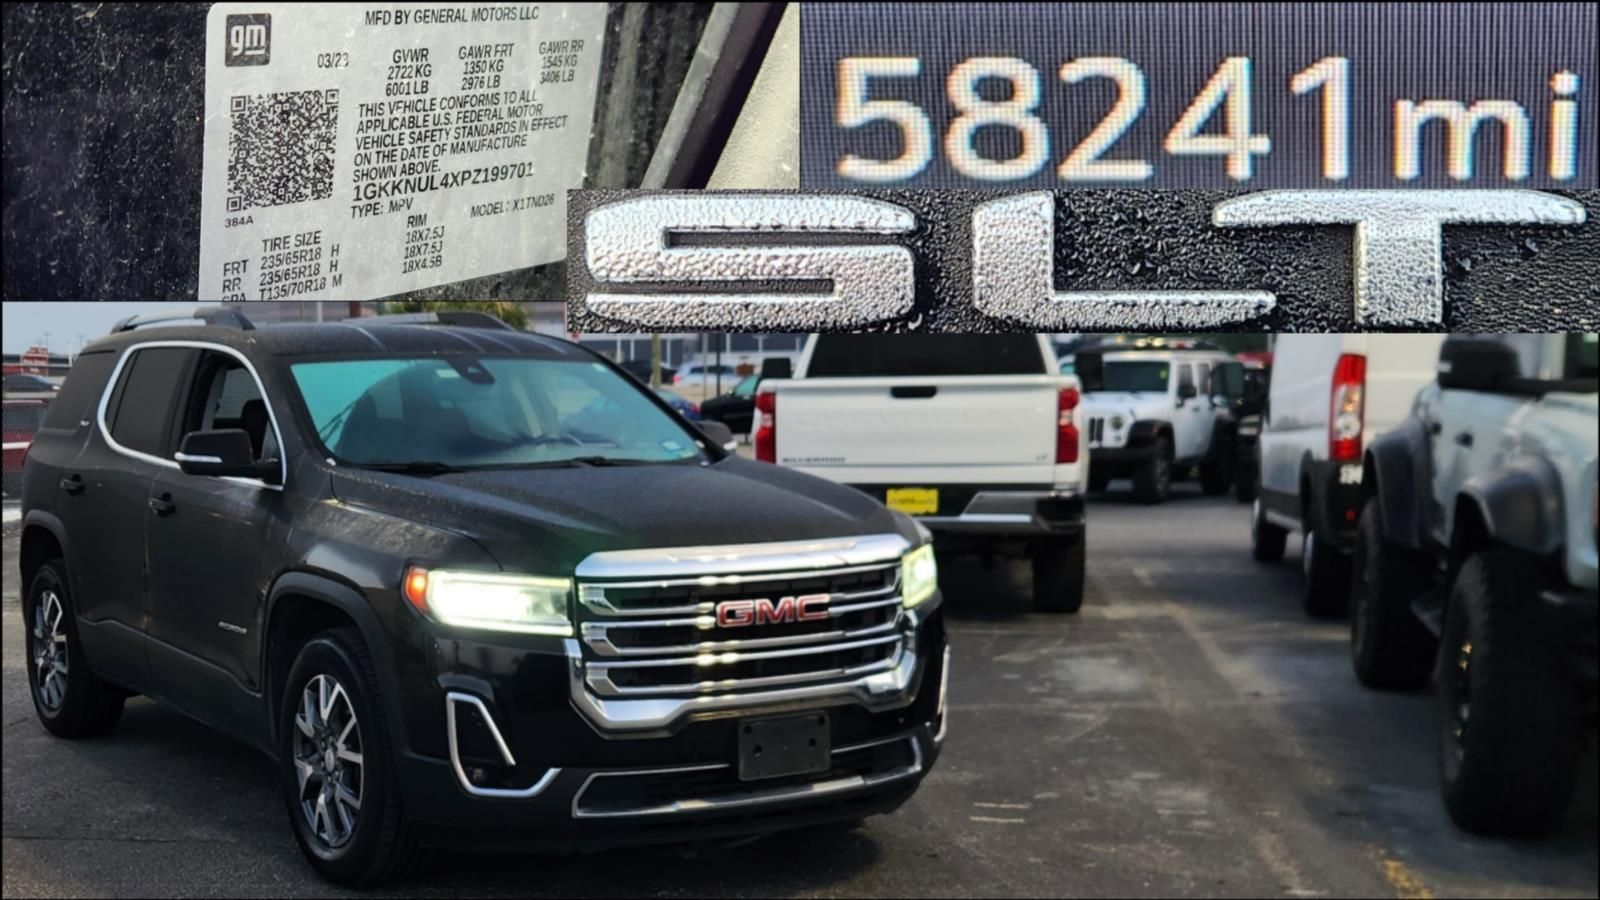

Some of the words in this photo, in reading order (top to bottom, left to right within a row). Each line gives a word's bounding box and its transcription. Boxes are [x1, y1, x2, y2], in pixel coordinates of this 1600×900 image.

[365, 11, 391, 25] MFD
[394, 10, 411, 25] BY
[414, 8, 468, 24] GENERAL
[471, 7, 518, 22] MOTORS
[519, 6, 540, 20] LLC
[392, 48, 429, 64] GVWR
[458, 45, 492, 60] GAWR
[494, 43, 515, 58] FRT
[538, 41, 567, 55] GAWR
[568, 40, 584, 53] RR
[387, 65, 413, 80] 2722
[415, 63, 432, 79] KG
[463, 60, 487, 75] 1350
[488, 59, 504, 73] KG
[541, 55, 563, 70] 1545
[563, 54, 578, 68] KG
[461, 76, 485, 91] 2976
[487, 75, 501, 89] LB
[540, 70, 561, 85] 3406
[562, 69, 575, 83] LB
[385, 81, 411, 97] 6001
[413, 80, 429, 95] LB
[358, 102, 385, 119] THIS
[388, 98, 437, 115] VEHICLE
[439, 93, 500, 110] CONFORMS
[504, 91, 515, 105] TO
[516, 89, 538, 103] ALL
[356, 114, 430, 135] APPLICABLE
[432, 112, 453, 127] U.S.
[456, 107, 504, 125] FEDERAL
[506, 103, 544, 120] MOTOR
[835, 55, 1350, 183] 58241
[1393, 69, 1581, 183] mi
[355, 132, 406, 151] VEHICLE
[408, 127, 451, 145] SAFETY
[453, 121, 517, 140] STANDARDS
[518, 119, 529, 133] IN
[530, 115, 568, 132] EFFECT
[353, 152, 372, 167] ON
[374, 149, 398, 165] THE
[400, 145, 430, 162] DATE
[432, 143, 448, 158] OF
[450, 134, 528, 155] MANUFACTURE
[352, 165, 397, 183] SHOWN
[399, 159, 442, 177] ABOVE.
[352, 161, 534, 201] 1GKKNUL4XPZ199701
[350, 203, 384, 220] TYPE:
[388, 197, 414, 213] MPV
[224, 215, 254, 228] 384A
[406, 214, 427, 228] RIM
[262, 235, 291, 253] TIRE
[294, 231, 322, 248] SIZE
[405, 226, 445, 244] 18X7.5J
[223, 259, 249, 277] FRT
[260, 247, 322, 270] 235/65R18
[330, 244, 340, 258] H
[403, 241, 443, 260] 18X7.5J
[585, 189, 1587, 328] SLT
[401, 255, 443, 275] 18X4.5B
[222, 277, 241, 294] RR
[259, 263, 321, 287] 235/65R18
[329, 259, 339, 273] H
[258, 277, 327, 302] T135/70R18
[332, 274, 343, 288] M
[716, 593, 830, 628] GMC
